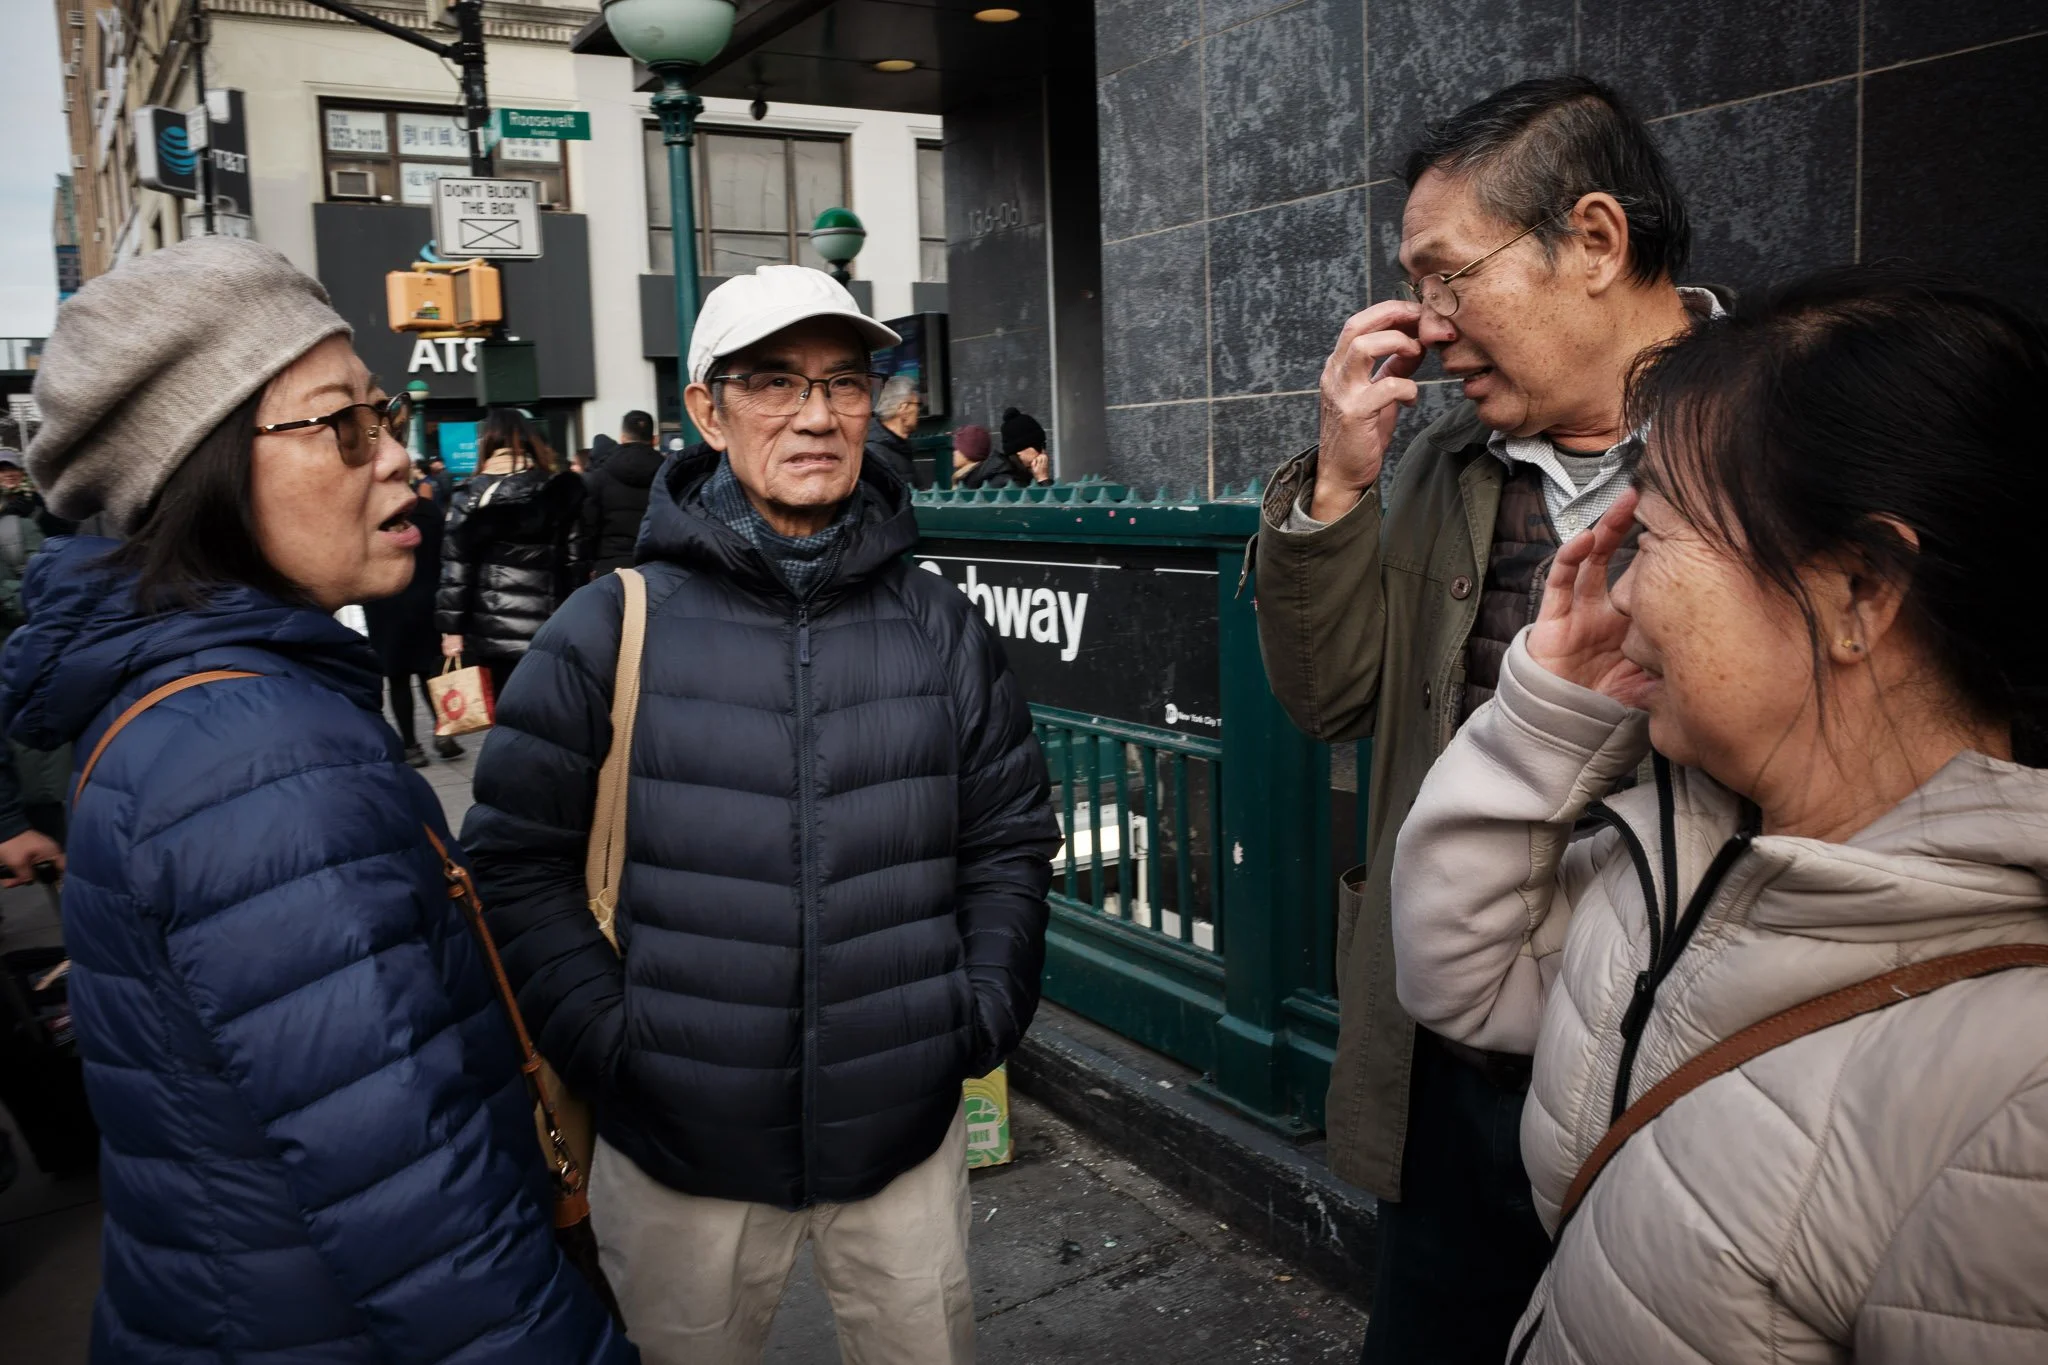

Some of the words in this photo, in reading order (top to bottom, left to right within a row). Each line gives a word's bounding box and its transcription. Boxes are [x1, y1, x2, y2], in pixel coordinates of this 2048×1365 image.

[508, 111, 576, 129] Roosevelt
[208, 148, 247, 173] T&T
[444, 184, 482, 198] DON'T
[487, 186, 530, 199] BLOCK
[461, 201, 486, 215] THE
[490, 202, 517, 215] BOX
